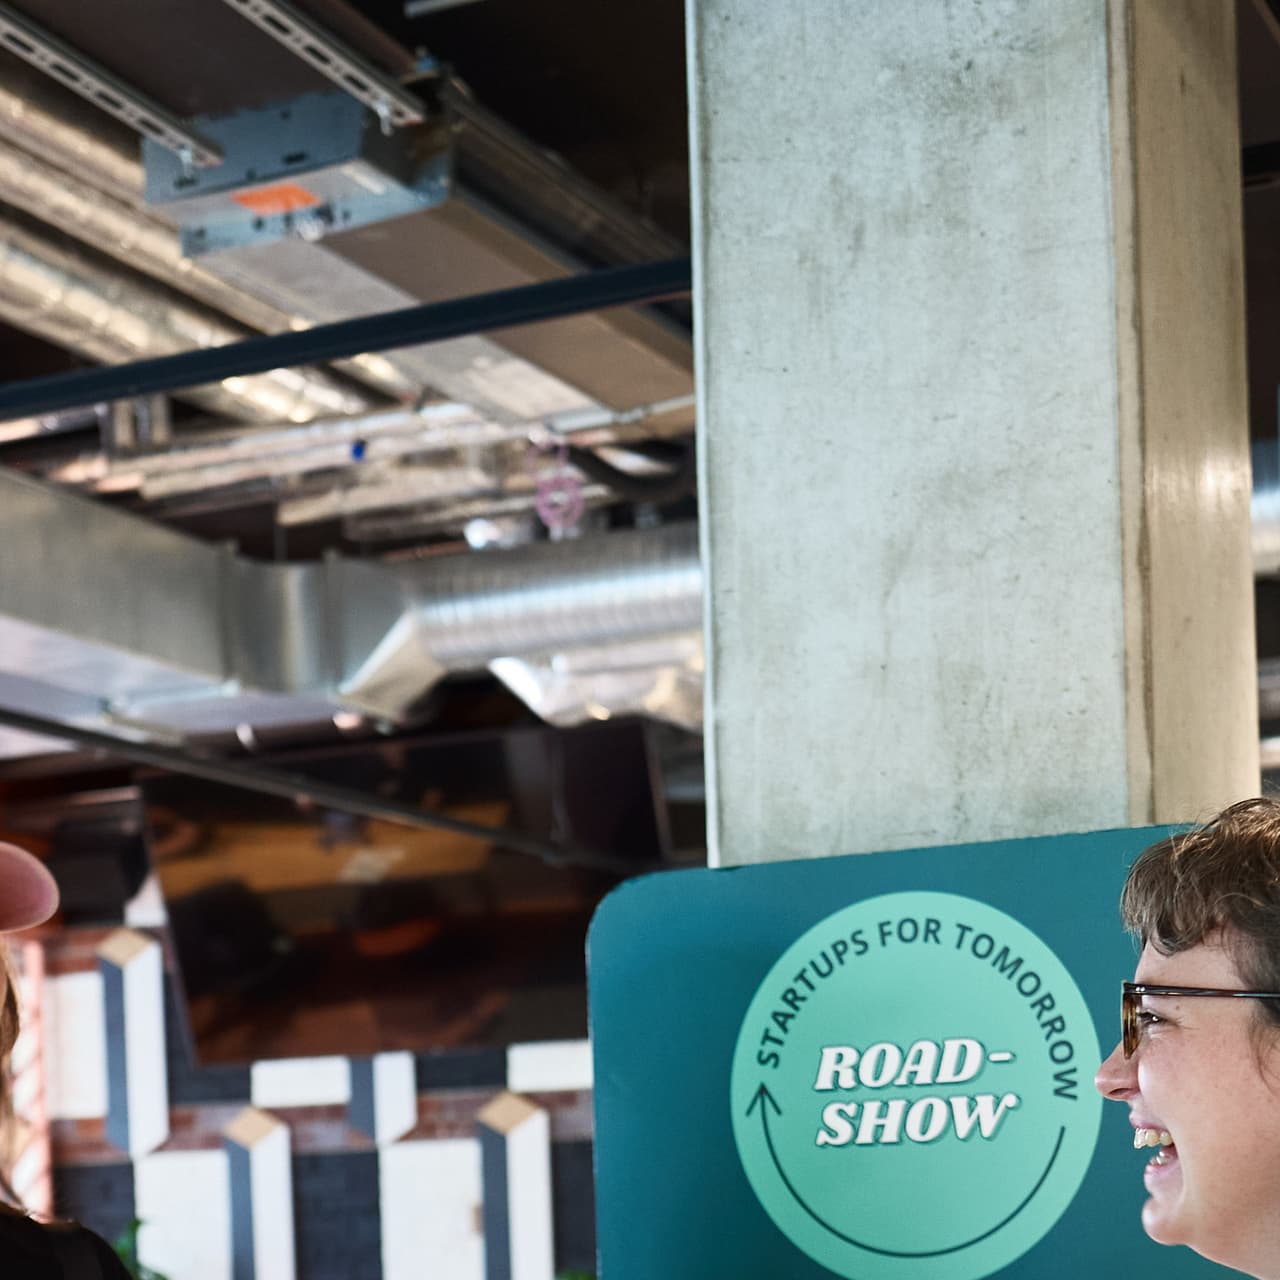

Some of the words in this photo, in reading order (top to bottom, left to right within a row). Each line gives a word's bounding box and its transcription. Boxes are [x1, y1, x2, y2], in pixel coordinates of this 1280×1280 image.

[757, 928, 870, 1069] STARTUPS
[878, 917, 943, 948] FOR
[954, 922, 1079, 1102] TOMORROW
[814, 1037, 1017, 1091] ROAD-
[815, 1093, 1021, 1147] SHOW
